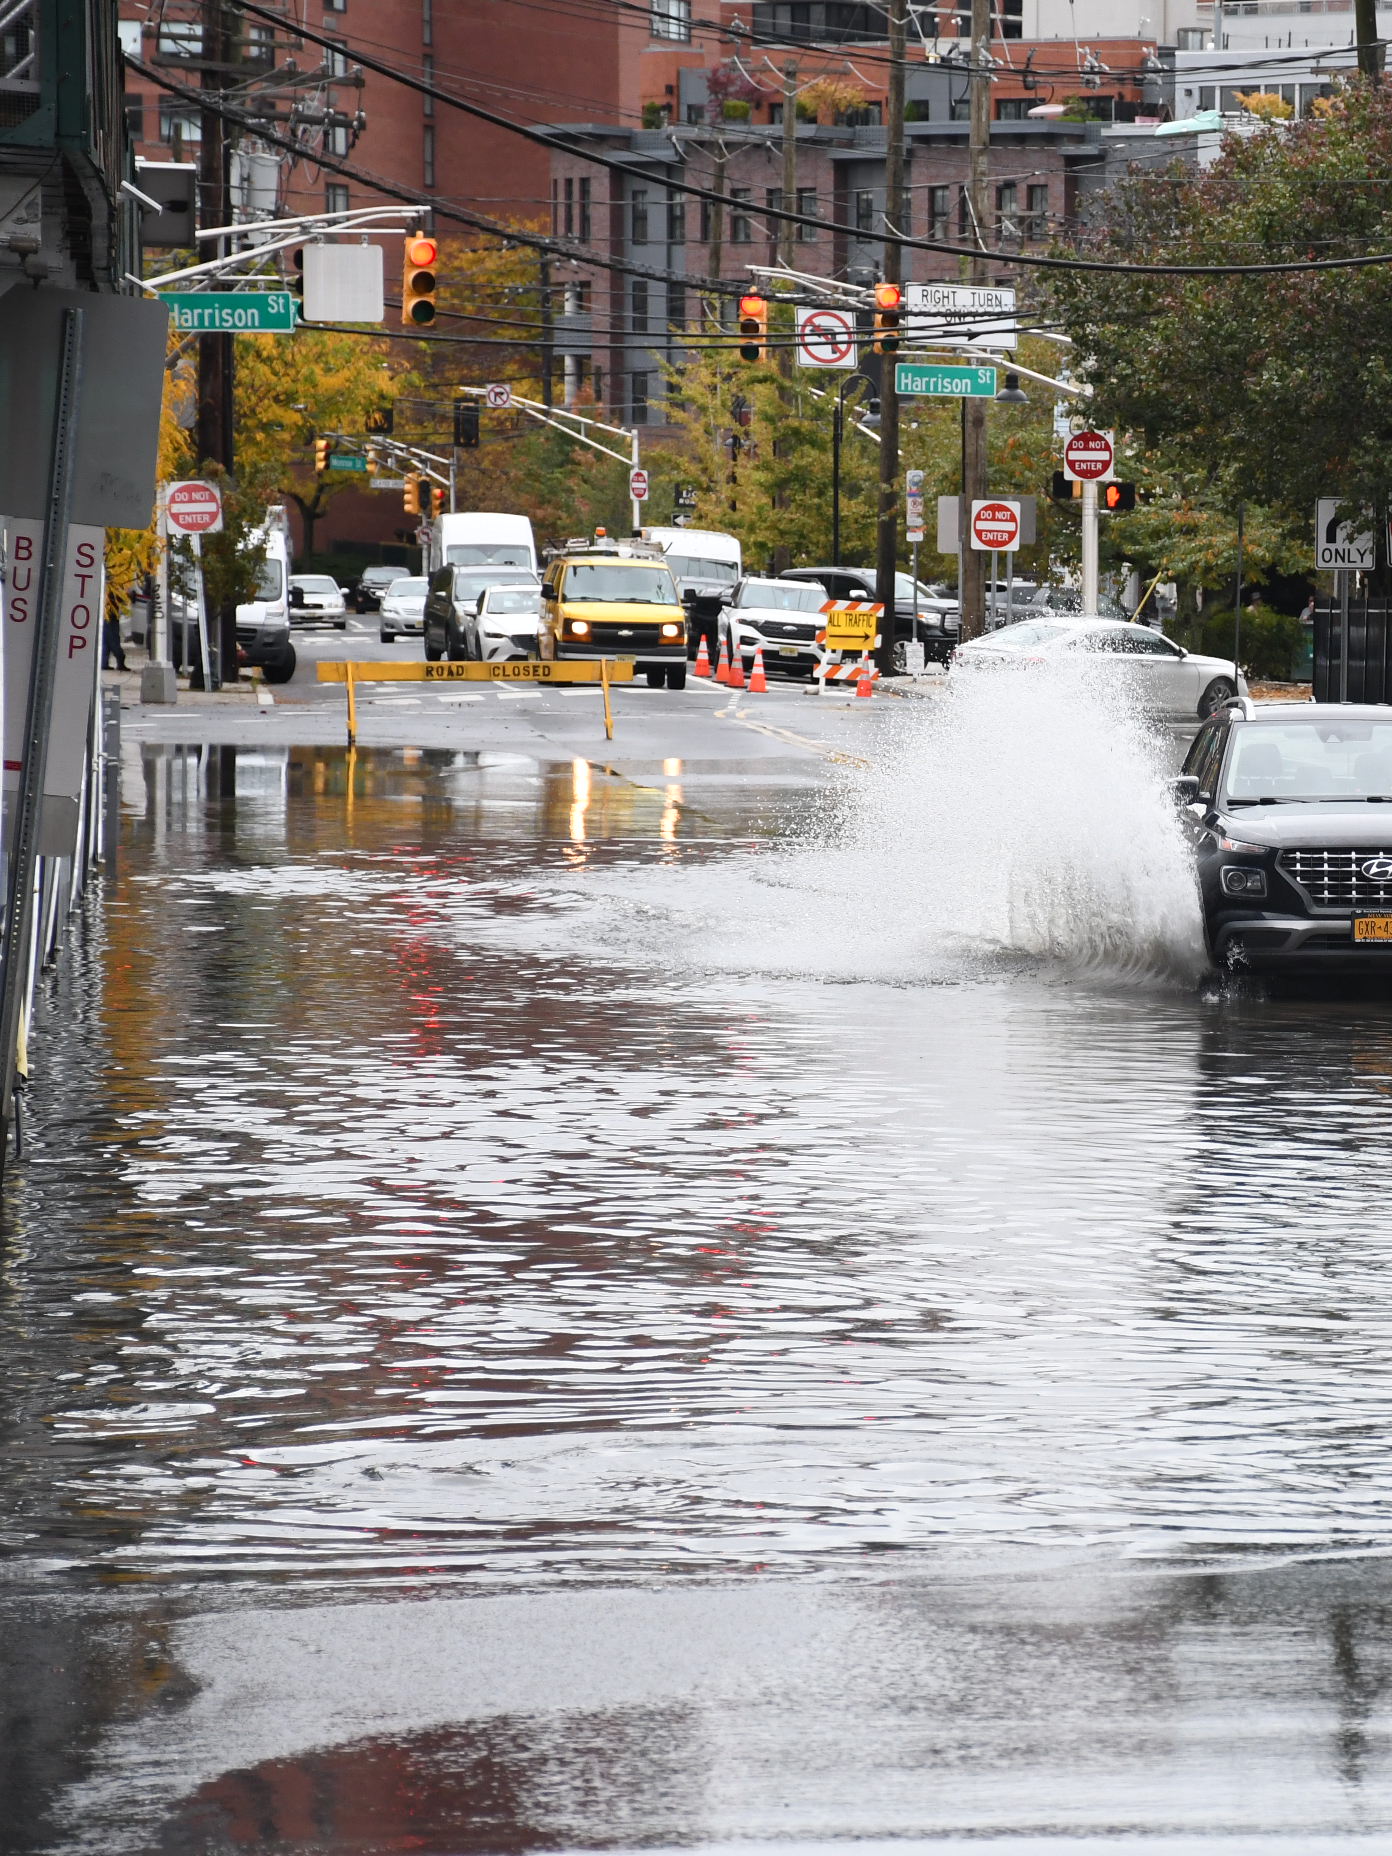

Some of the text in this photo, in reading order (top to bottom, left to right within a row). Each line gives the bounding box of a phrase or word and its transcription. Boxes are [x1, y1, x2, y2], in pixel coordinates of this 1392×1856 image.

[921, 289, 1003, 308] RIGHT TURN
[168, 295, 286, 328] Harrison St
[900, 369, 992, 393] Harrison St
[1072, 440, 1106, 449] DO NOT
[1074, 462, 1103, 471] ENTER
[174, 491, 210, 502] DO NOT
[179, 513, 210, 524] ENTER
[980, 510, 1012, 520] DO NOT
[981, 531, 1010, 541] ENTER
[1321, 547, 1370, 564] ONLY
[9, 535, 33, 623] BUS
[68, 542, 96, 659] STOP
[827, 612, 874, 629] ALL TRAFFIC
[425, 664, 552, 678] ROAD CLOSED
